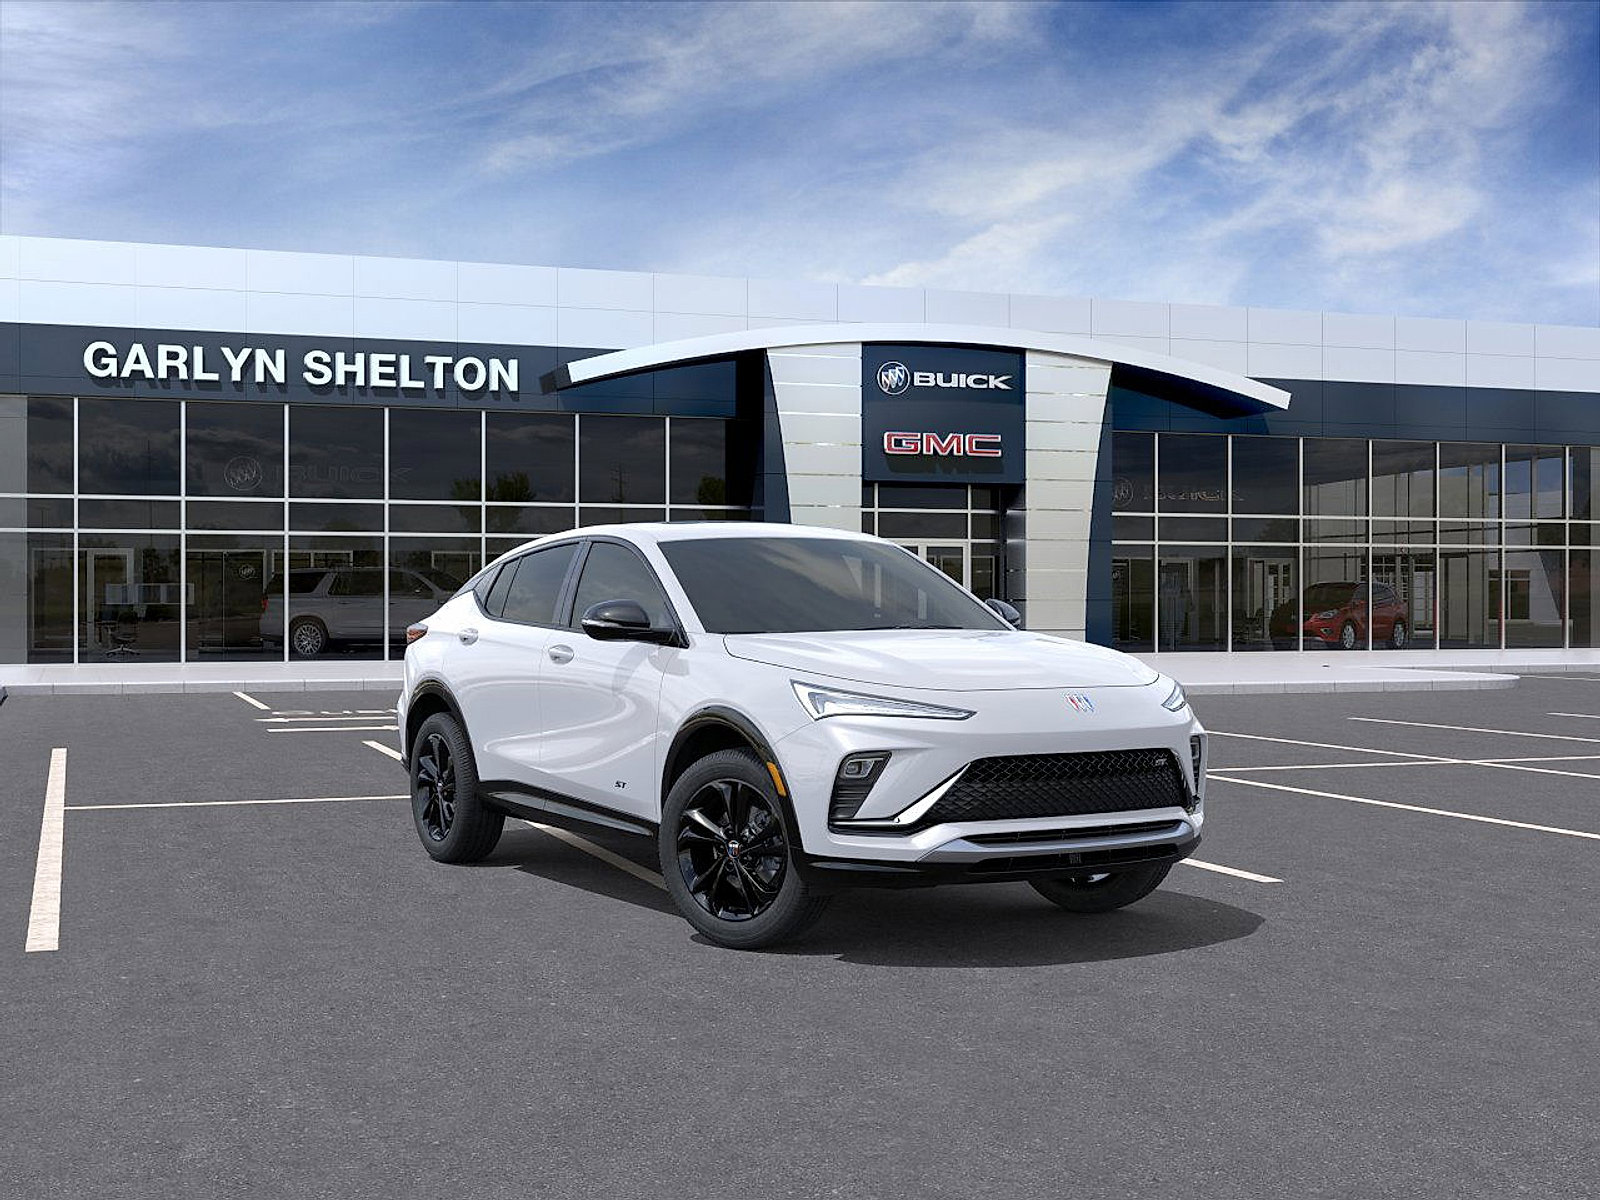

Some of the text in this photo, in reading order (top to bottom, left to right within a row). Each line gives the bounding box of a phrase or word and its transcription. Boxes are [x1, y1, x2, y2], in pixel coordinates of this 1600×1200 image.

[83, 341, 519, 392] GARLYN SHELTON
[913, 371, 1013, 390] BUICK
[884, 431, 1002, 457] GMC
[614, 780, 628, 789] ST
